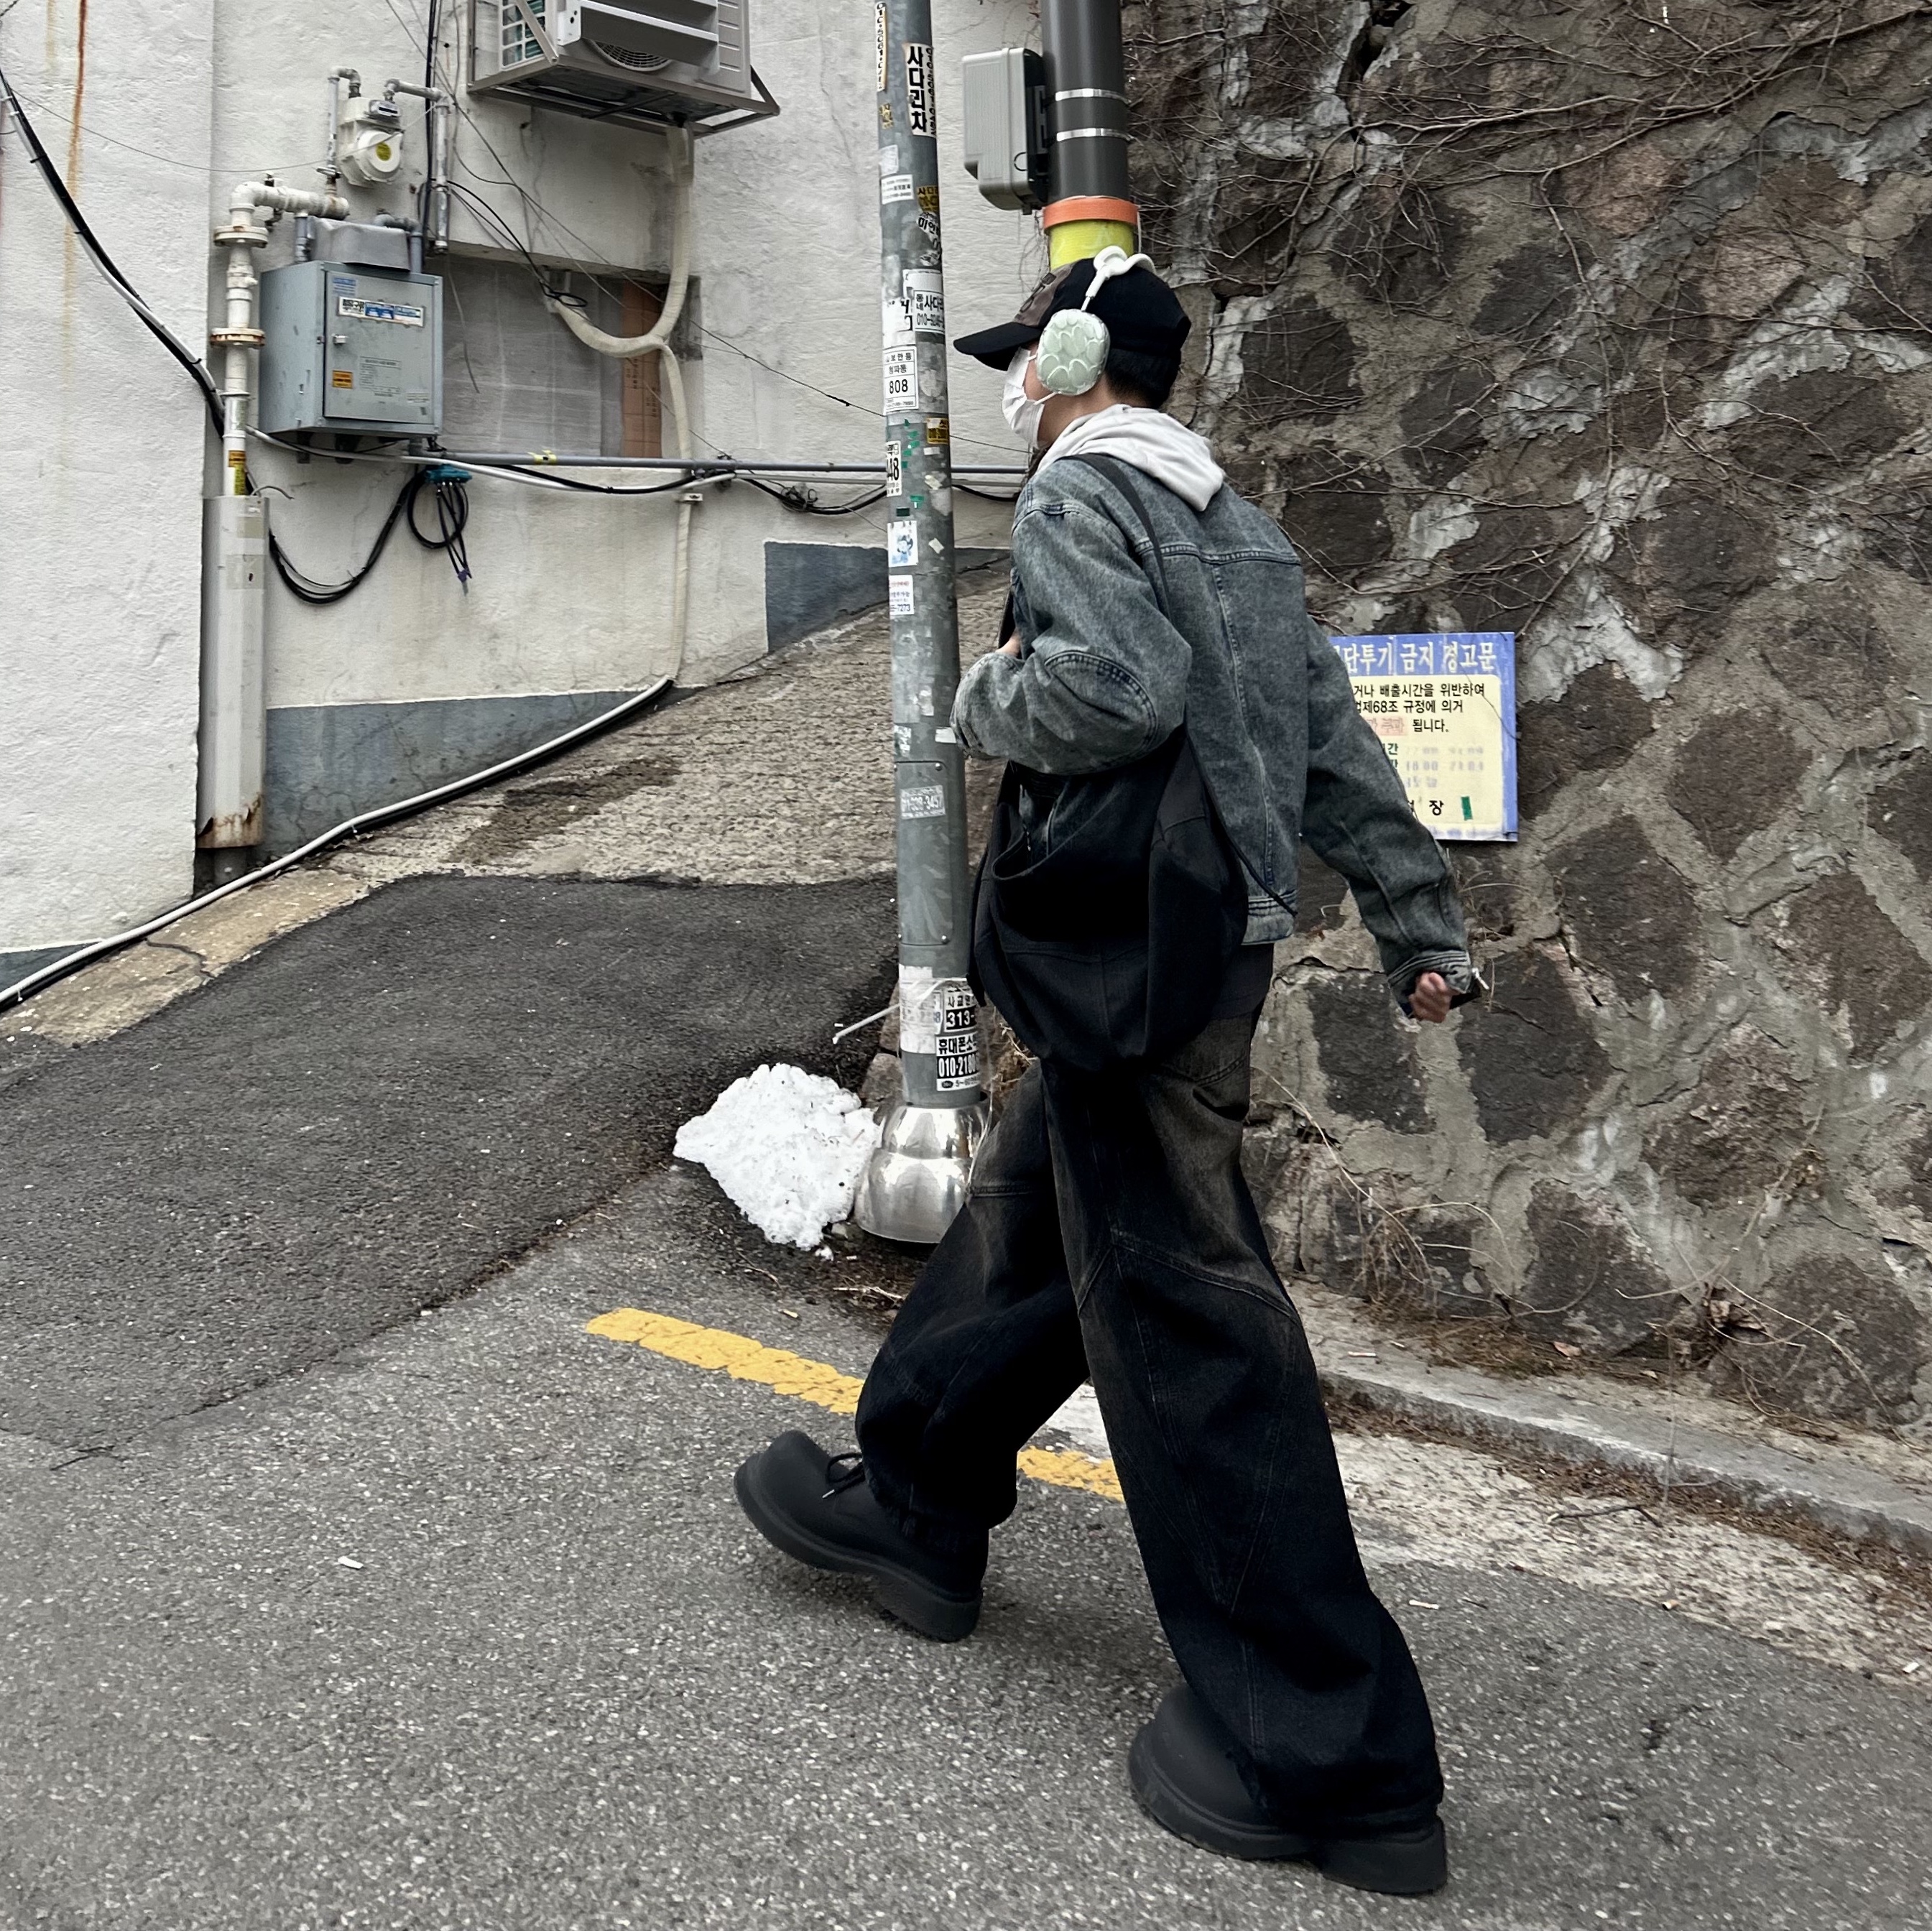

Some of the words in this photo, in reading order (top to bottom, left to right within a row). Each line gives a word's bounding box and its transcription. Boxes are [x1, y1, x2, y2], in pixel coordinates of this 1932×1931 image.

[907, 46, 927, 132] 사다리차
[889, 379, 908, 394] 808
[1334, 642, 1393, 675] 단투기
[1400, 642, 1434, 674] 금지
[1443, 642, 1497, 673] 경고문
[1379, 683, 1434, 698] 배출시간을
[1440, 683, 1485, 697] 위반하여
[1403, 700, 1436, 713] 규정에
[1441, 700, 1464, 713] 의거
[1413, 718, 1449, 733] 됩니다.
